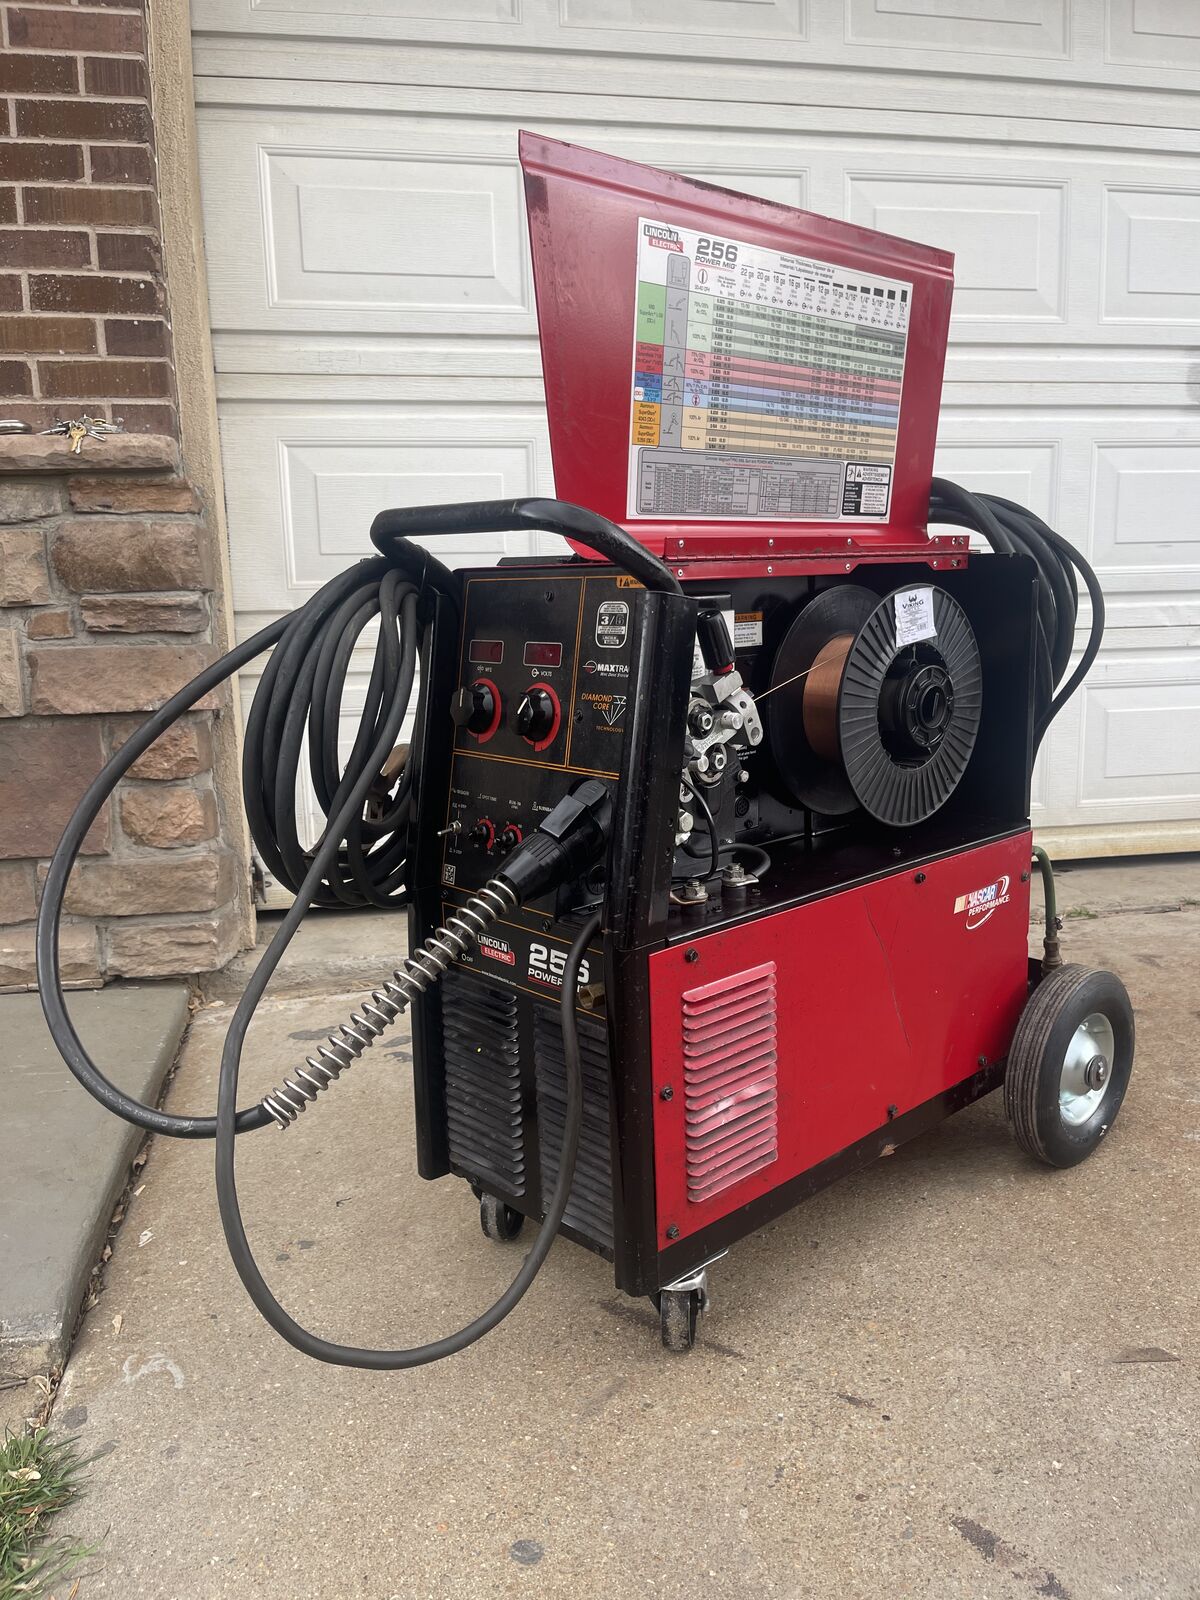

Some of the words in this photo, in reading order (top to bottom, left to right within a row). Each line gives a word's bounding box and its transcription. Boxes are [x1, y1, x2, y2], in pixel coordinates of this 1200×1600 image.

[645, 225, 678, 241] LINCOLN
[696, 238, 738, 262] 256
[695, 256, 720, 266] POWER
[722, 261, 736, 270] MIG
[740, 268, 747, 276] 22
[756, 272, 763, 280] 20
[902, 600, 924, 609] VIKING
[597, 663, 629, 673] MAXTRA
[581, 693, 613, 702] DIAMOND
[593, 702, 609, 711] CORE
[968, 885, 997, 909] NASCAR
[968, 894, 1010, 916] PERFORMANCE
[477, 934, 509, 952] LINCOLN
[484, 947, 512, 962] ELECTRIC
